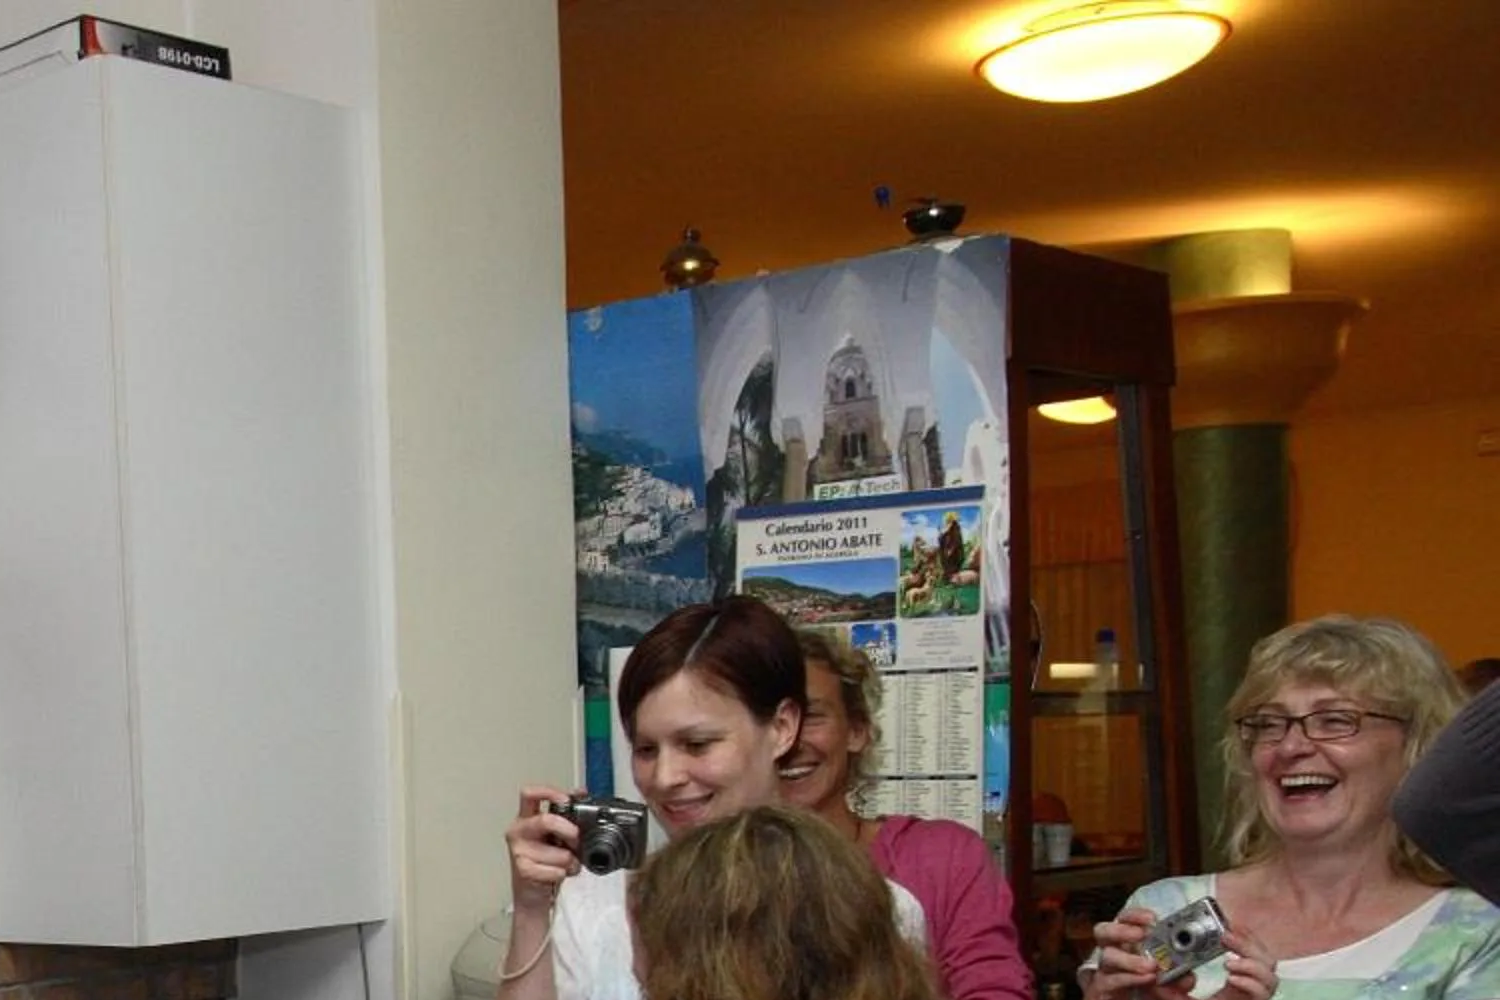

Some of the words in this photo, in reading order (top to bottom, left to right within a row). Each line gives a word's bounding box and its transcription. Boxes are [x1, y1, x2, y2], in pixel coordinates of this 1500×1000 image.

[765, 517, 833, 537] Calendario
[837, 517, 867, 531] 2011
[756, 543, 767, 556] S.
[770, 538, 837, 555] ANTONIO
[841, 534, 883, 549] ABATE
